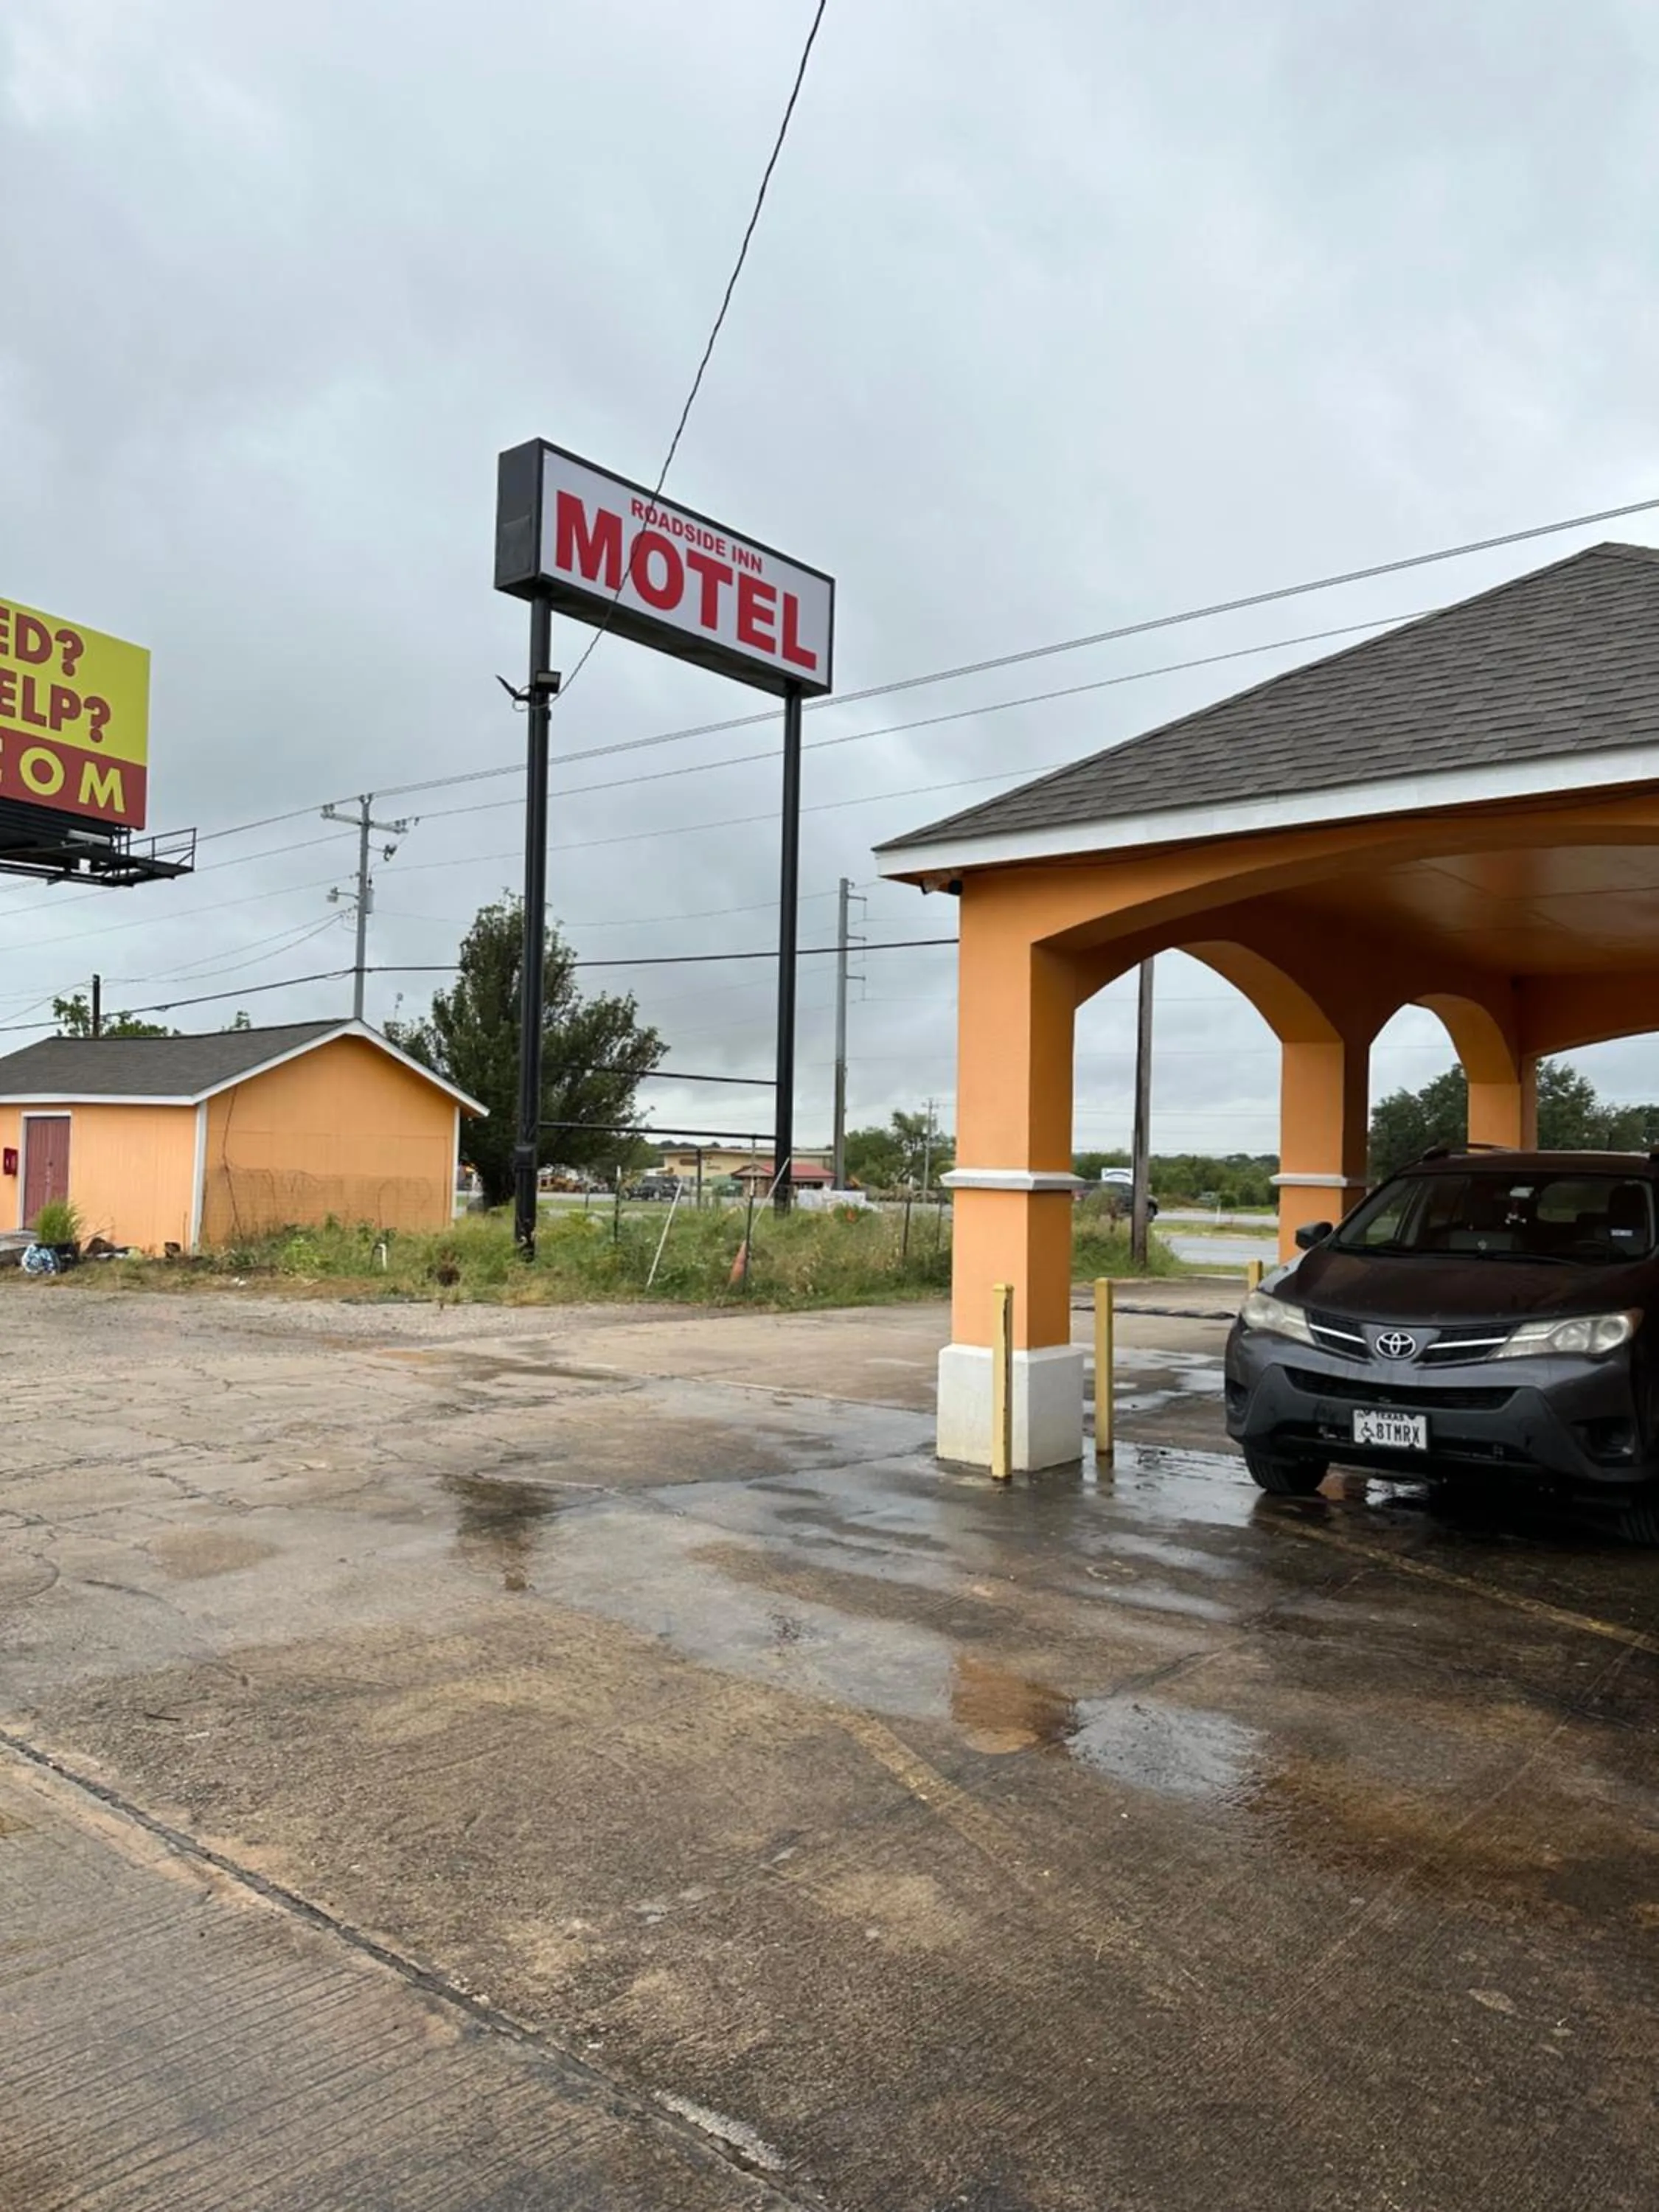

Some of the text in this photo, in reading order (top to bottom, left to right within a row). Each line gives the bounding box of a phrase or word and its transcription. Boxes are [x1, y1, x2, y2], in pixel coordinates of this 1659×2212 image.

[630, 498, 762, 574] ROADSIDE INN
[555, 490, 817, 672] MOTEL
[0, 738, 125, 813] OM
